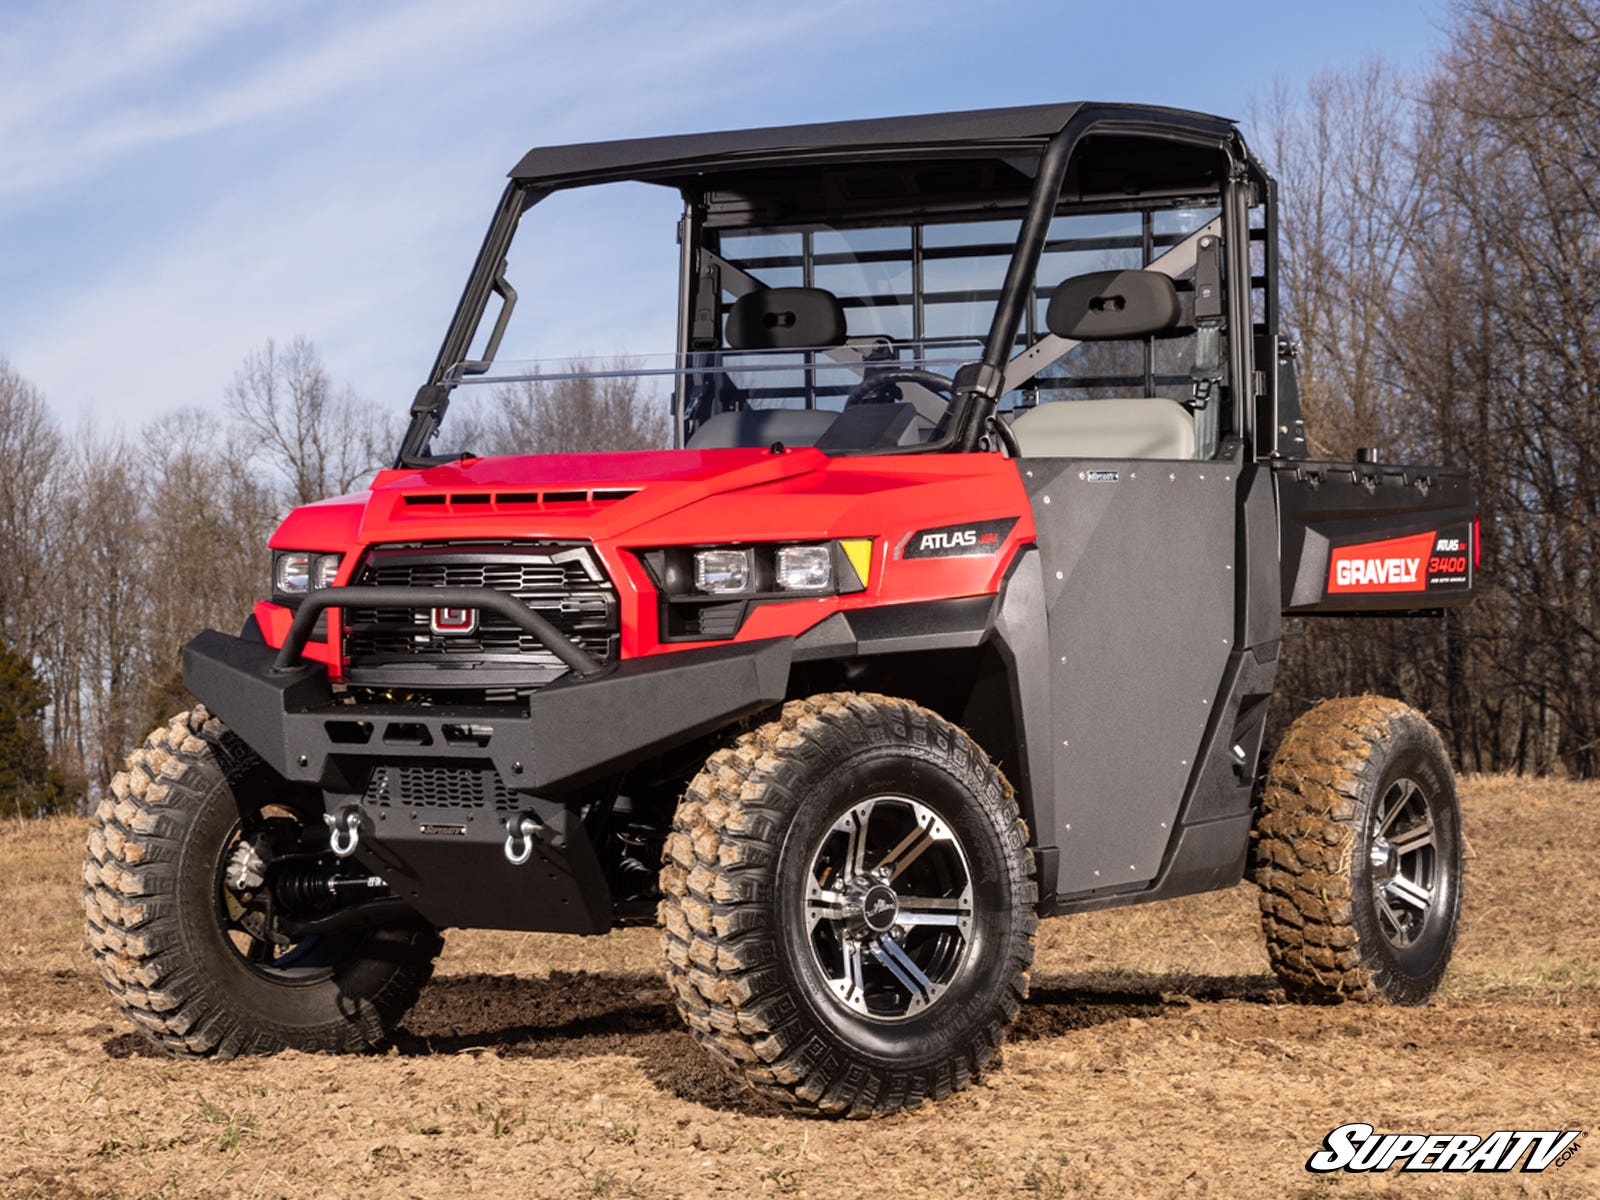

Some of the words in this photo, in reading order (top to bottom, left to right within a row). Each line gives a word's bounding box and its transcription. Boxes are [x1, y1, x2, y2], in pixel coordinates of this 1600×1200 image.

[920, 531, 976, 550] ATLAS
[1336, 558, 1420, 585] GRAVELY
[1429, 557, 1467, 573] 3400
